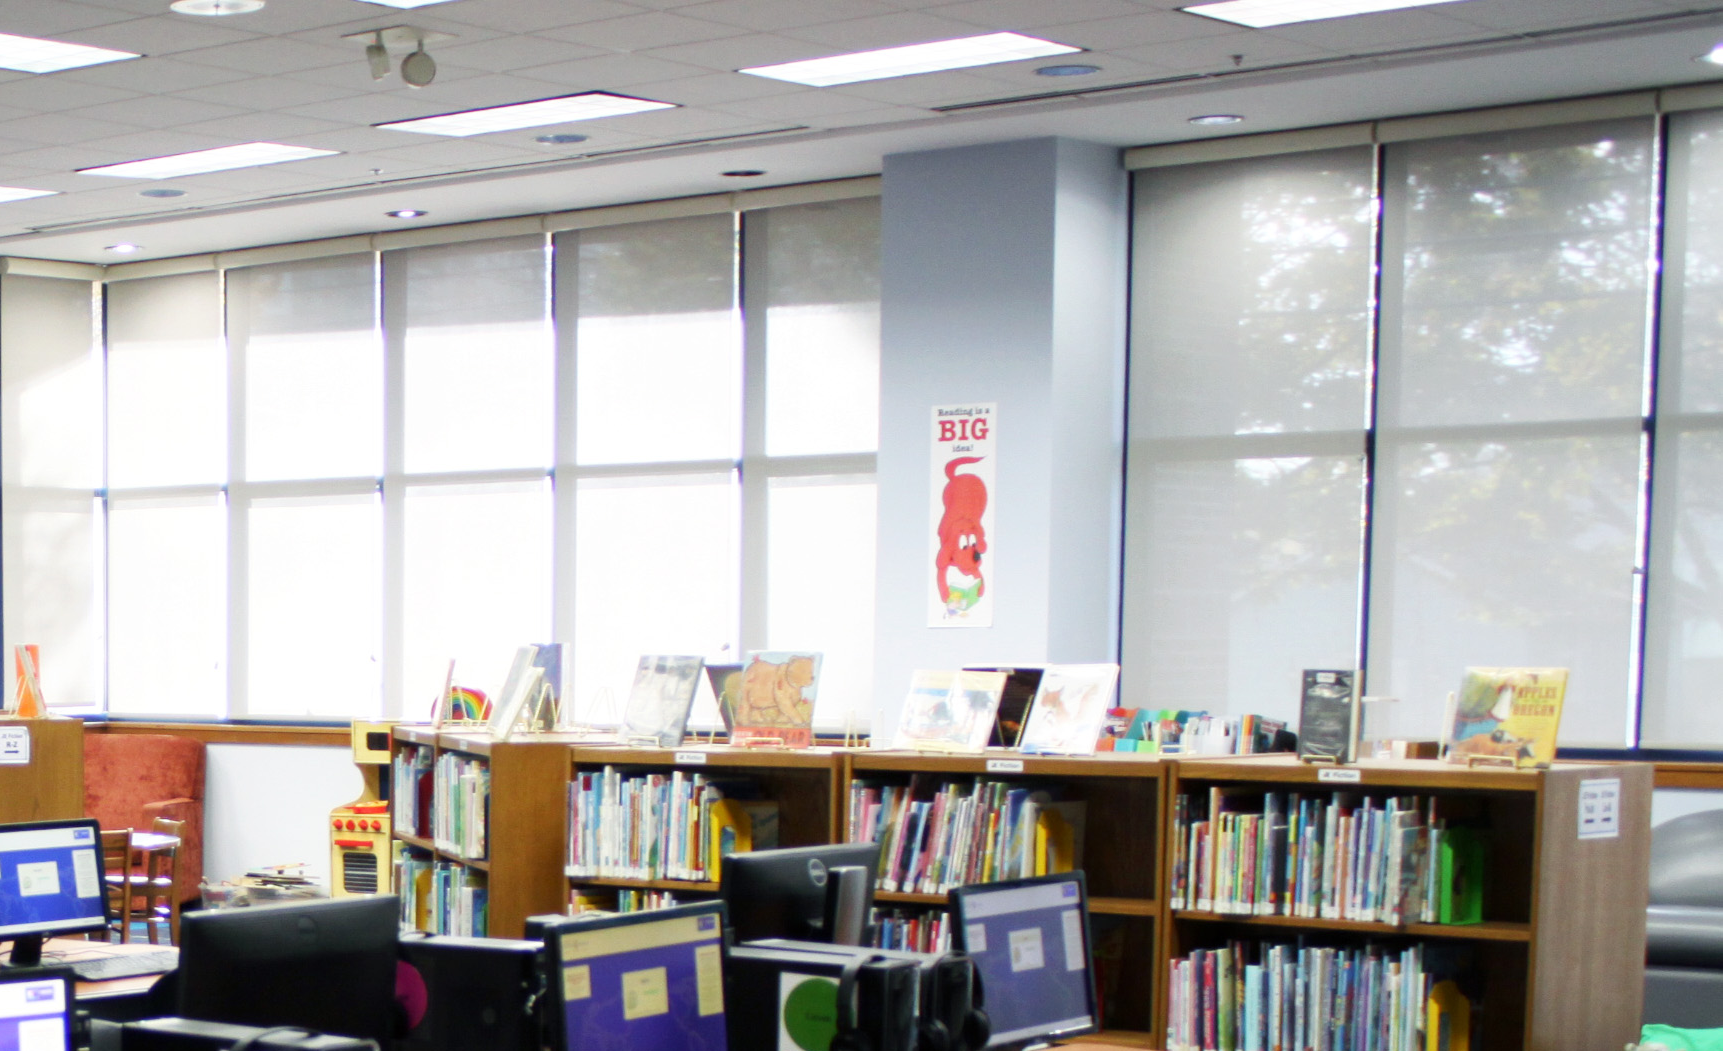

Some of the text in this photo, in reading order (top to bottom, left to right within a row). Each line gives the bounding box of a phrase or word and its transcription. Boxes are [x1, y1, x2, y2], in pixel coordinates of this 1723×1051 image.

[937, 408, 973, 416] Reading
[975, 406, 983, 414] is
[938, 418, 989, 442] BIG
[951, 444, 974, 452] idea!
